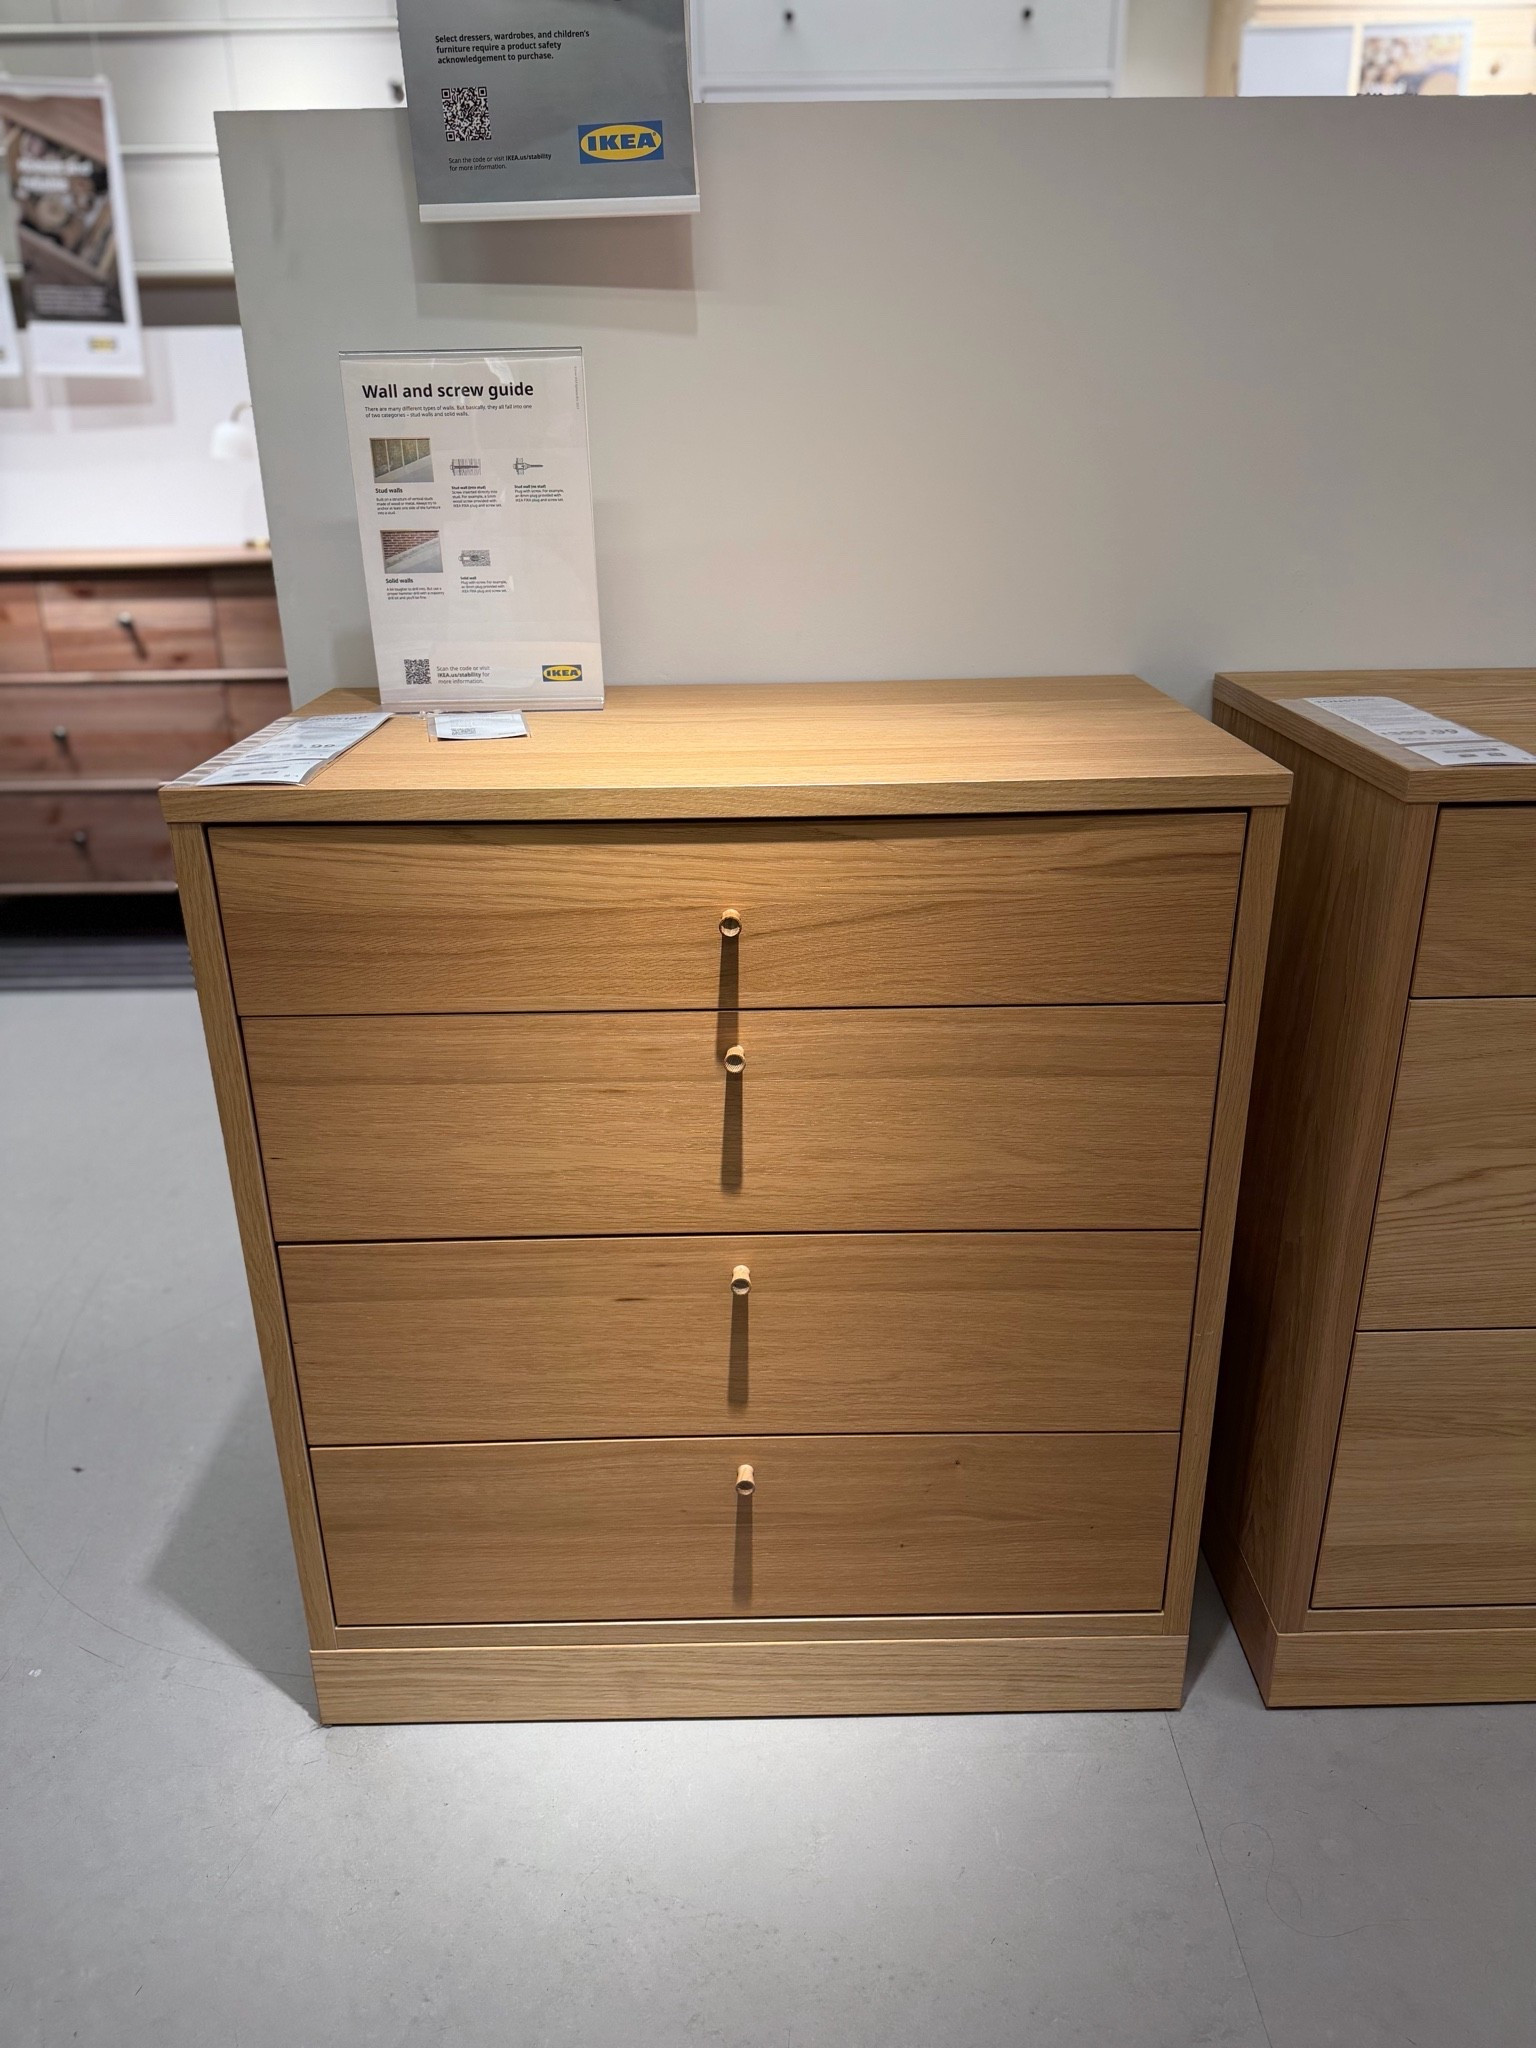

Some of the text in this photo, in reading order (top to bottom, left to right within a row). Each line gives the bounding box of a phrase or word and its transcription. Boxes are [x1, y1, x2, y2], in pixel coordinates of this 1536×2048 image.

[435, 35, 457, 43] Select
[538, 30, 552, 38] and
[554, 30, 590, 38] children's
[472, 43, 499, 53] require
[508, 42, 536, 52] product
[538, 41, 561, 50] safety
[438, 55, 506, 64] acknowledgement
[518, 52, 554, 62] purchase.
[588, 133, 656, 151] IKEA
[362, 382, 533, 400] Wall and screw guide
